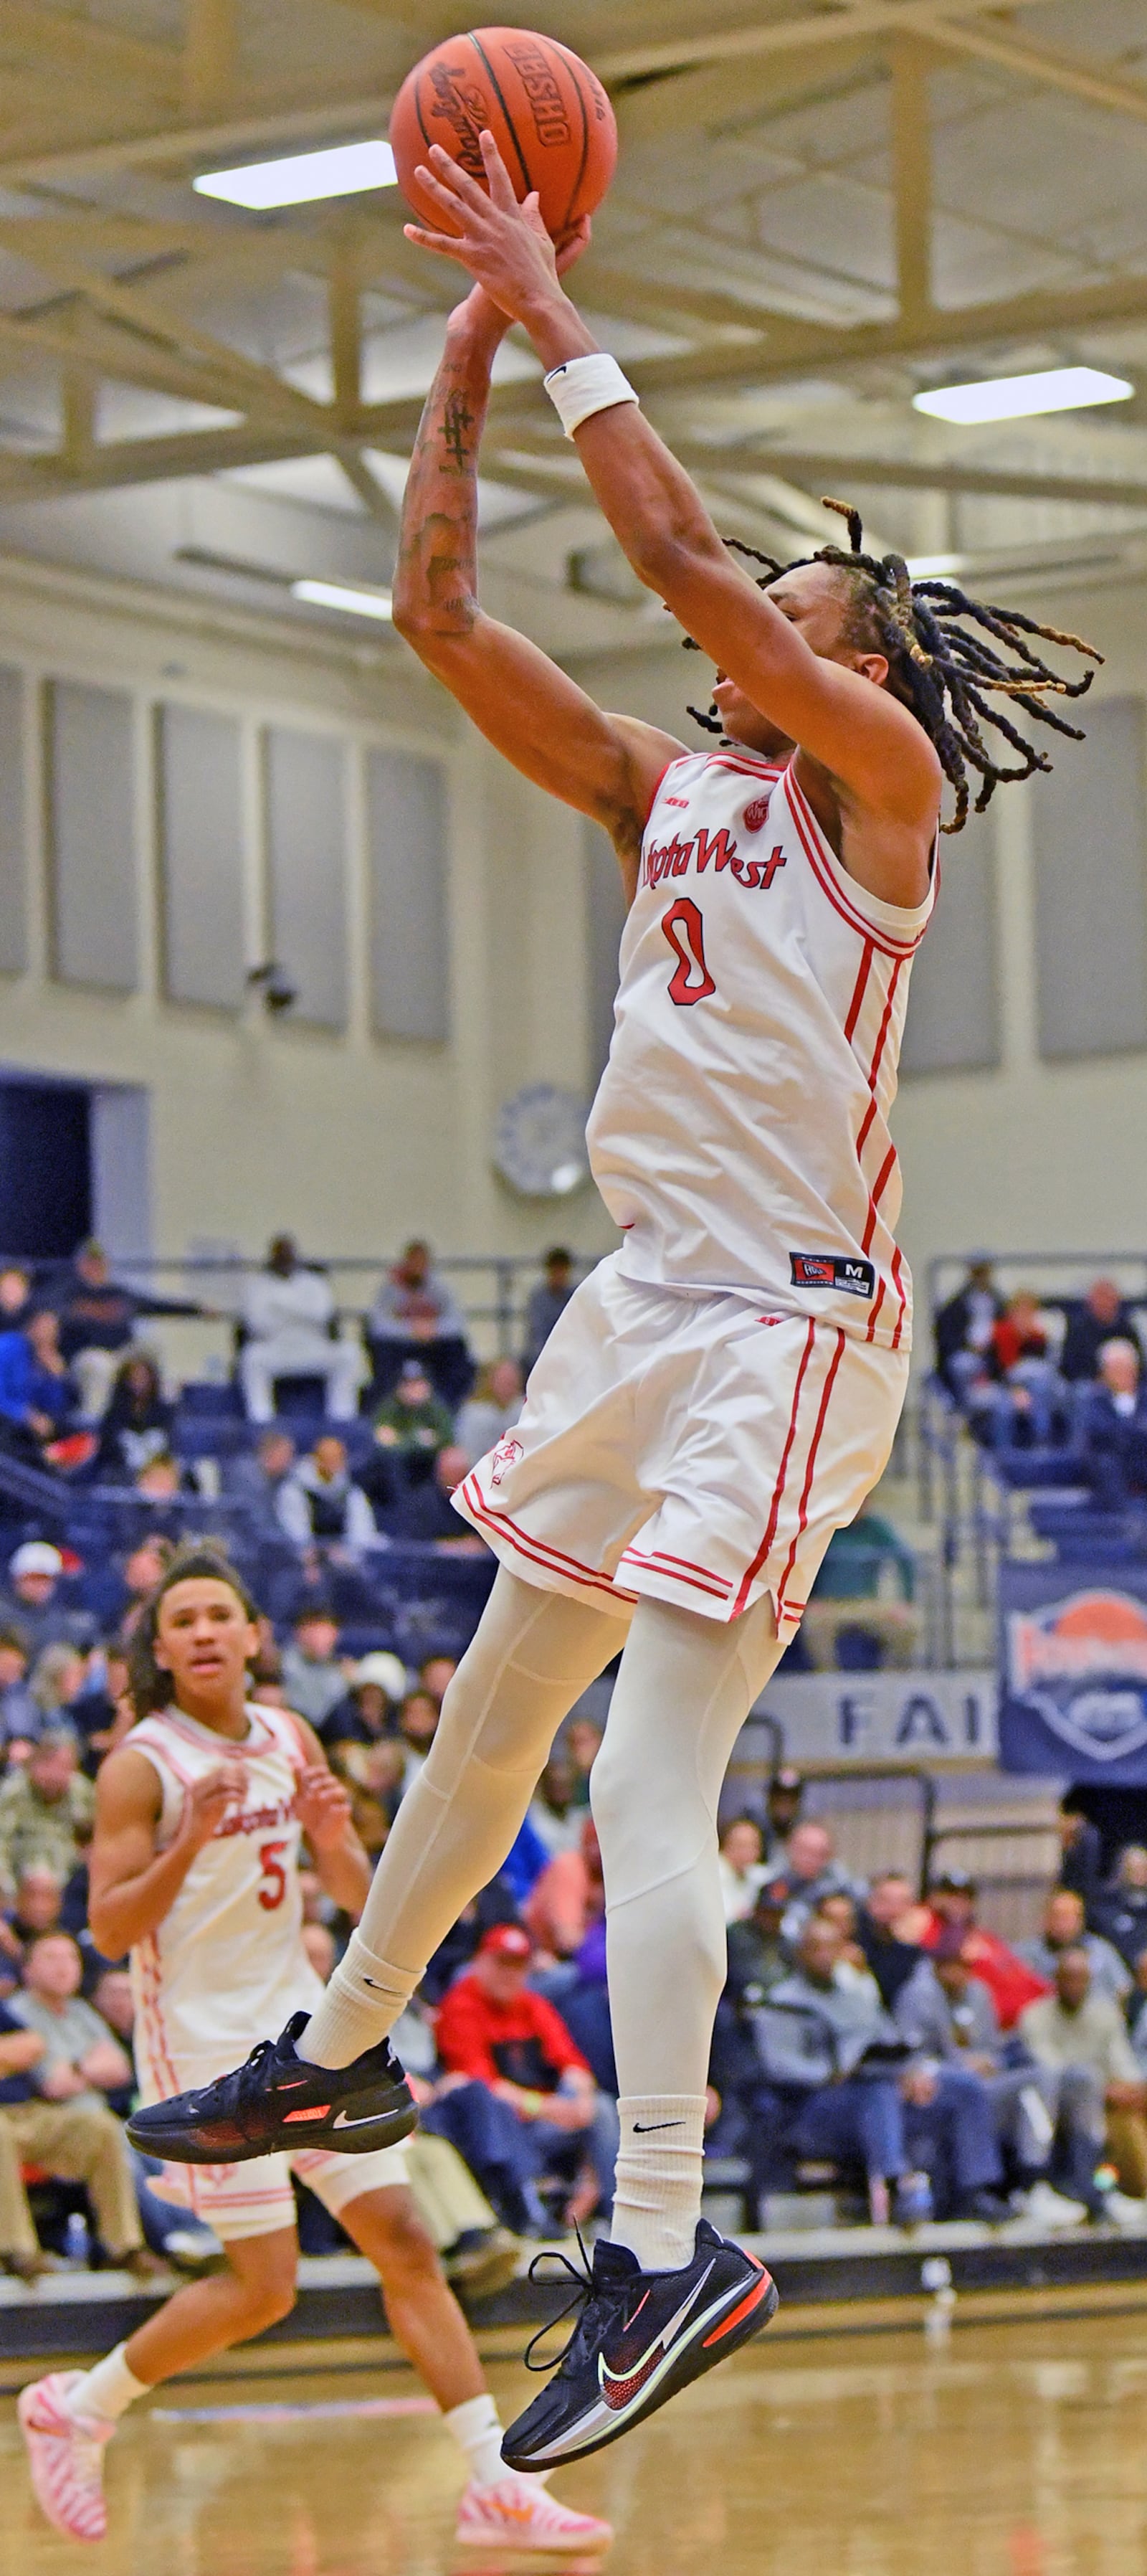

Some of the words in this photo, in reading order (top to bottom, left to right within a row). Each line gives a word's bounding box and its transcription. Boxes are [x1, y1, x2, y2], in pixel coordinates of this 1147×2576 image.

[661, 896, 716, 1006] 0
[845, 1264, 864, 1279] M
[258, 1841, 288, 1910] 5
